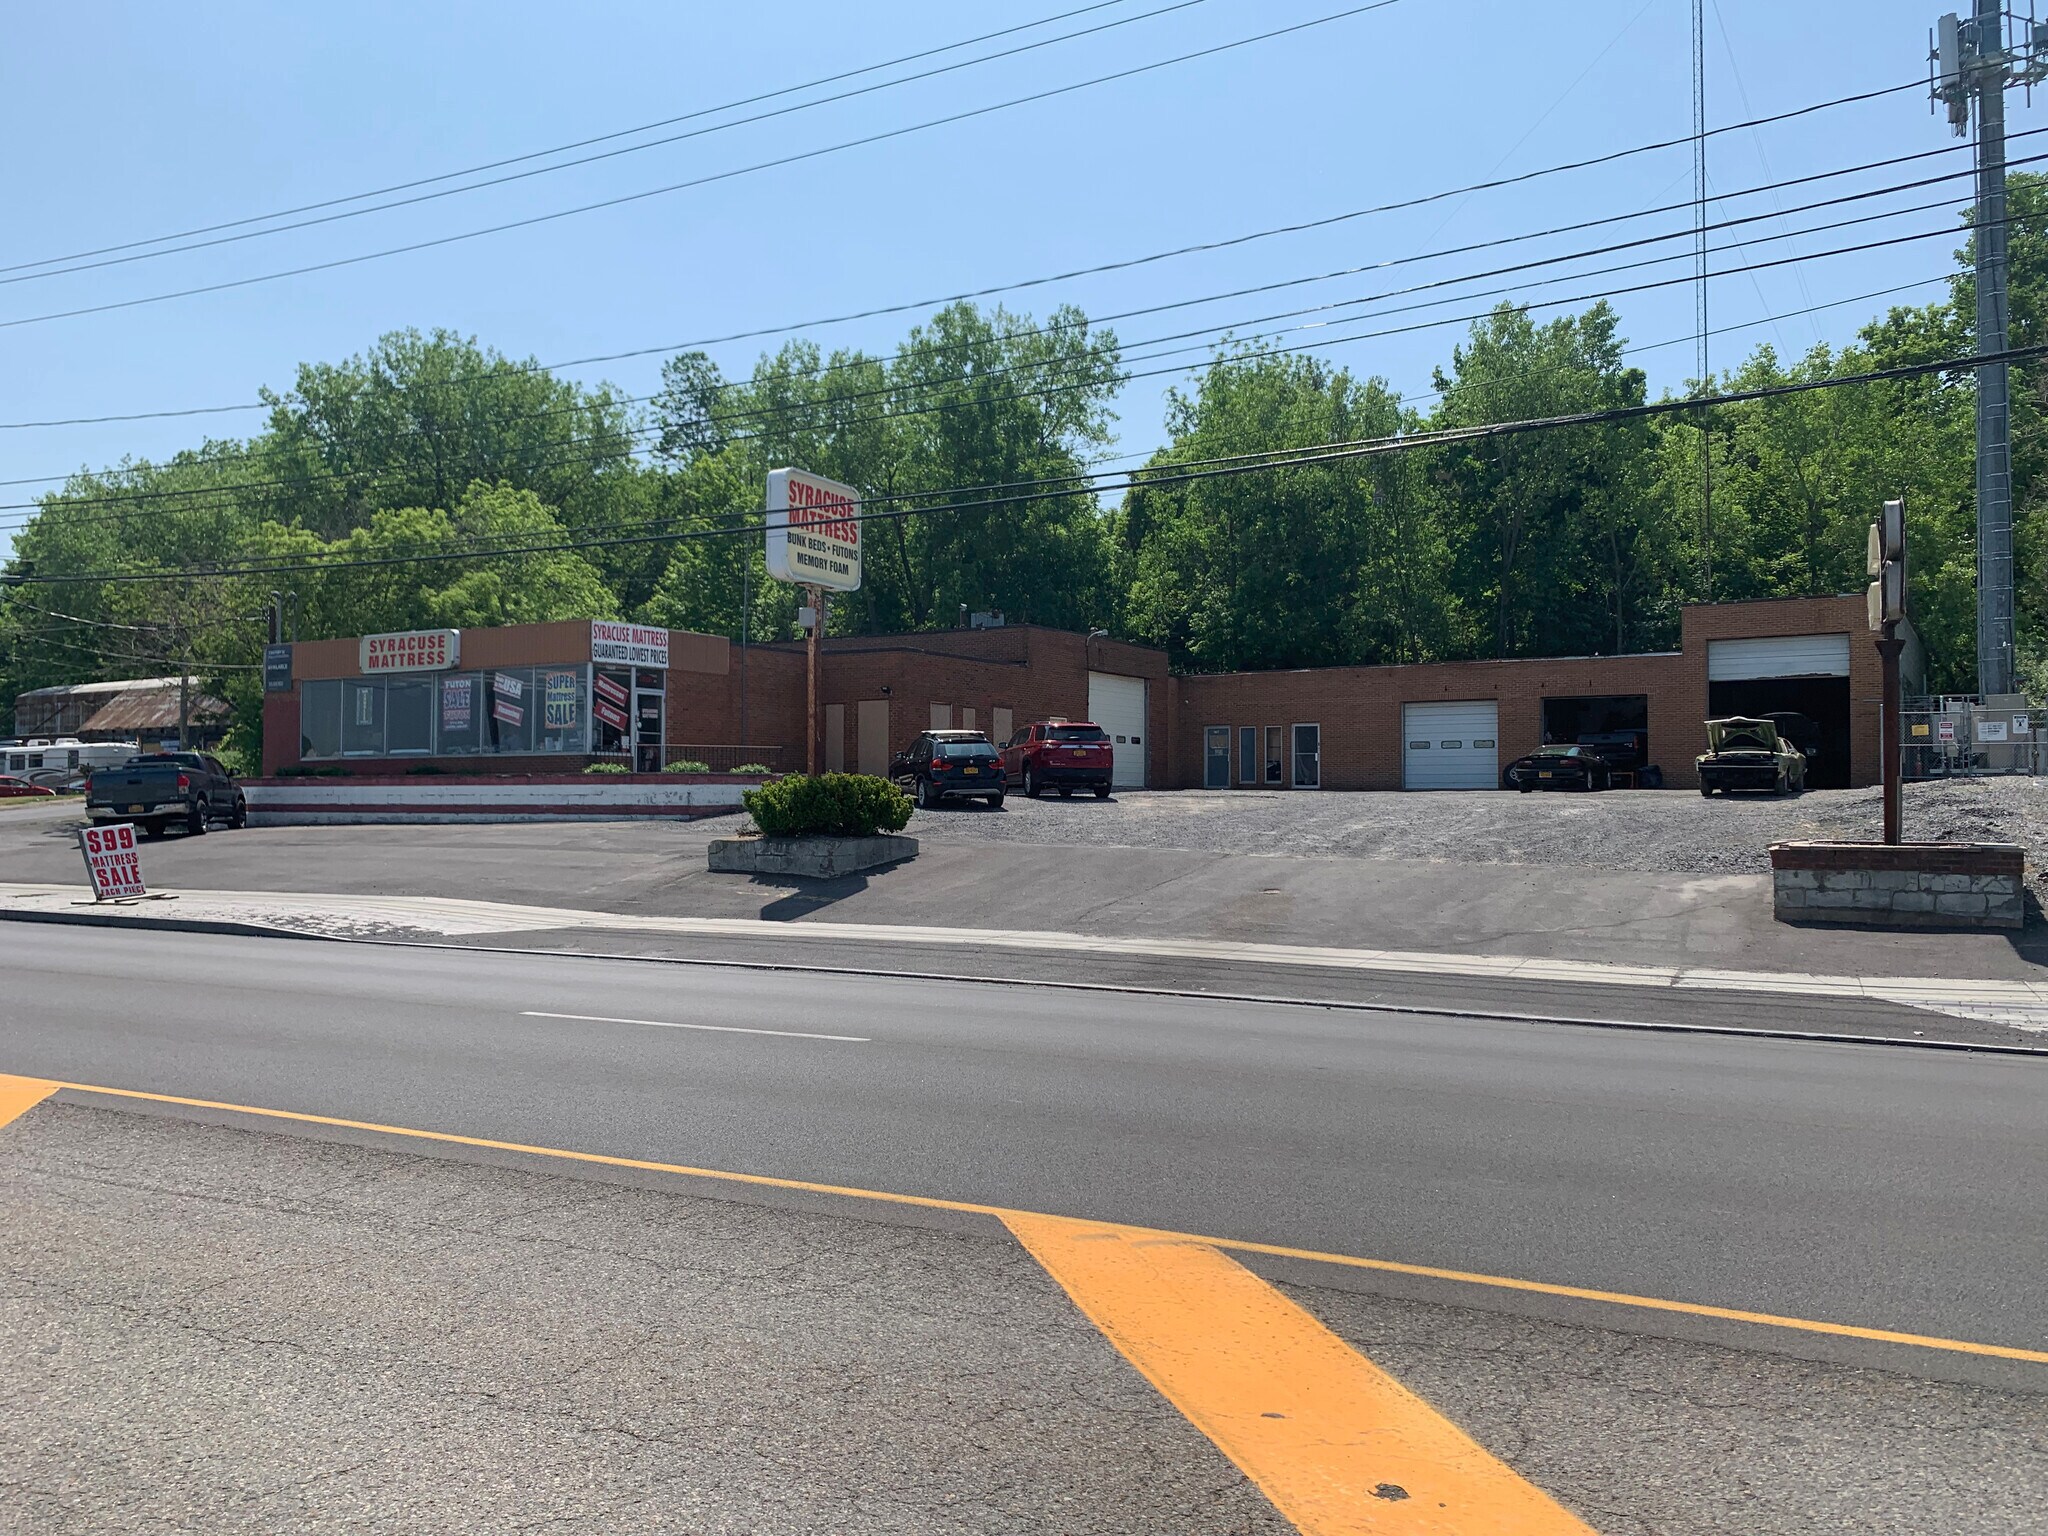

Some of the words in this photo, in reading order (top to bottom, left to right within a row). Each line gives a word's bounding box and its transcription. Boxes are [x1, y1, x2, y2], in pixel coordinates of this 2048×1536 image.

[789, 480, 854, 518] SYRACUSE
[789, 504, 857, 544] MATTRESS
[787, 532, 807, 548] BUNK
[808, 537, 827, 553] BEDS
[832, 544, 858, 561] FUTONS
[797, 552, 828, 570] MEMORY
[829, 561, 849, 575] FOAM
[369, 635, 445, 653] SYRACUSE
[593, 624, 630, 643] SYRACUSE
[632, 628, 667, 647] MATTRESS
[368, 651, 445, 669] MATTRESS
[593, 643, 628, 660] GUARANTEED
[629, 647, 650, 663] LOWEST
[650, 649, 667, 665] PRICES
[445, 680, 471, 689] FUTON
[503, 678, 522, 696] USA
[547, 674, 575, 689] SUPER
[443, 689, 471, 709] SALE
[547, 691, 575, 702] Mattress
[547, 703, 575, 725] SALE
[86, 828, 134, 854] $99
[91, 852, 138, 868] MATTRESS
[96, 865, 141, 887] SALE
